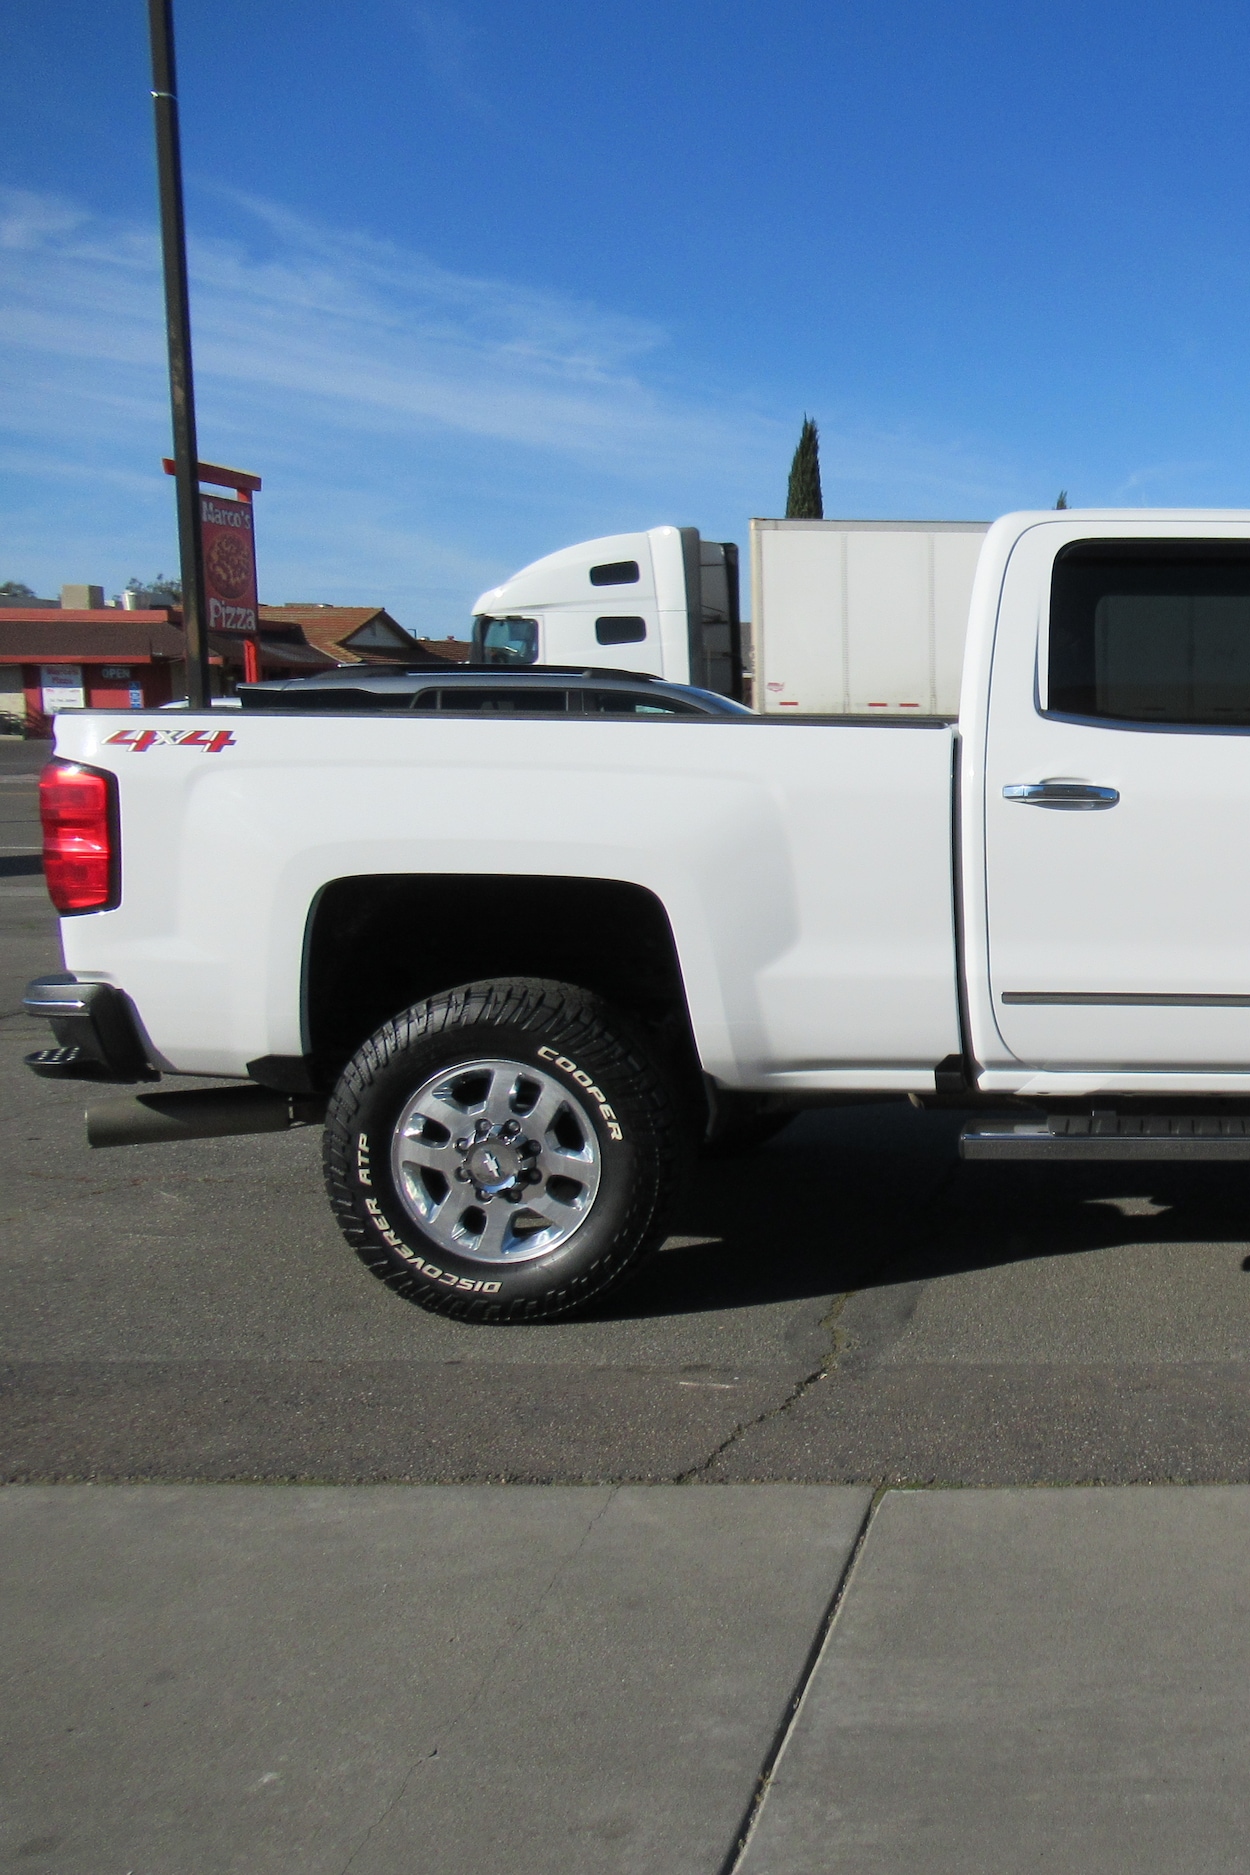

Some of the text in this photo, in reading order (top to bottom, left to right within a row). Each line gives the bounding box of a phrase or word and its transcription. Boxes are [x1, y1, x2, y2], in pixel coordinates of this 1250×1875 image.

[202, 501, 252, 530] Marco's
[208, 598, 256, 631] Pizza
[102, 668, 131, 679] OPEN
[537, 1045, 623, 1142] COOPER
[357, 1132, 503, 1293] DISCOVERER ATP
